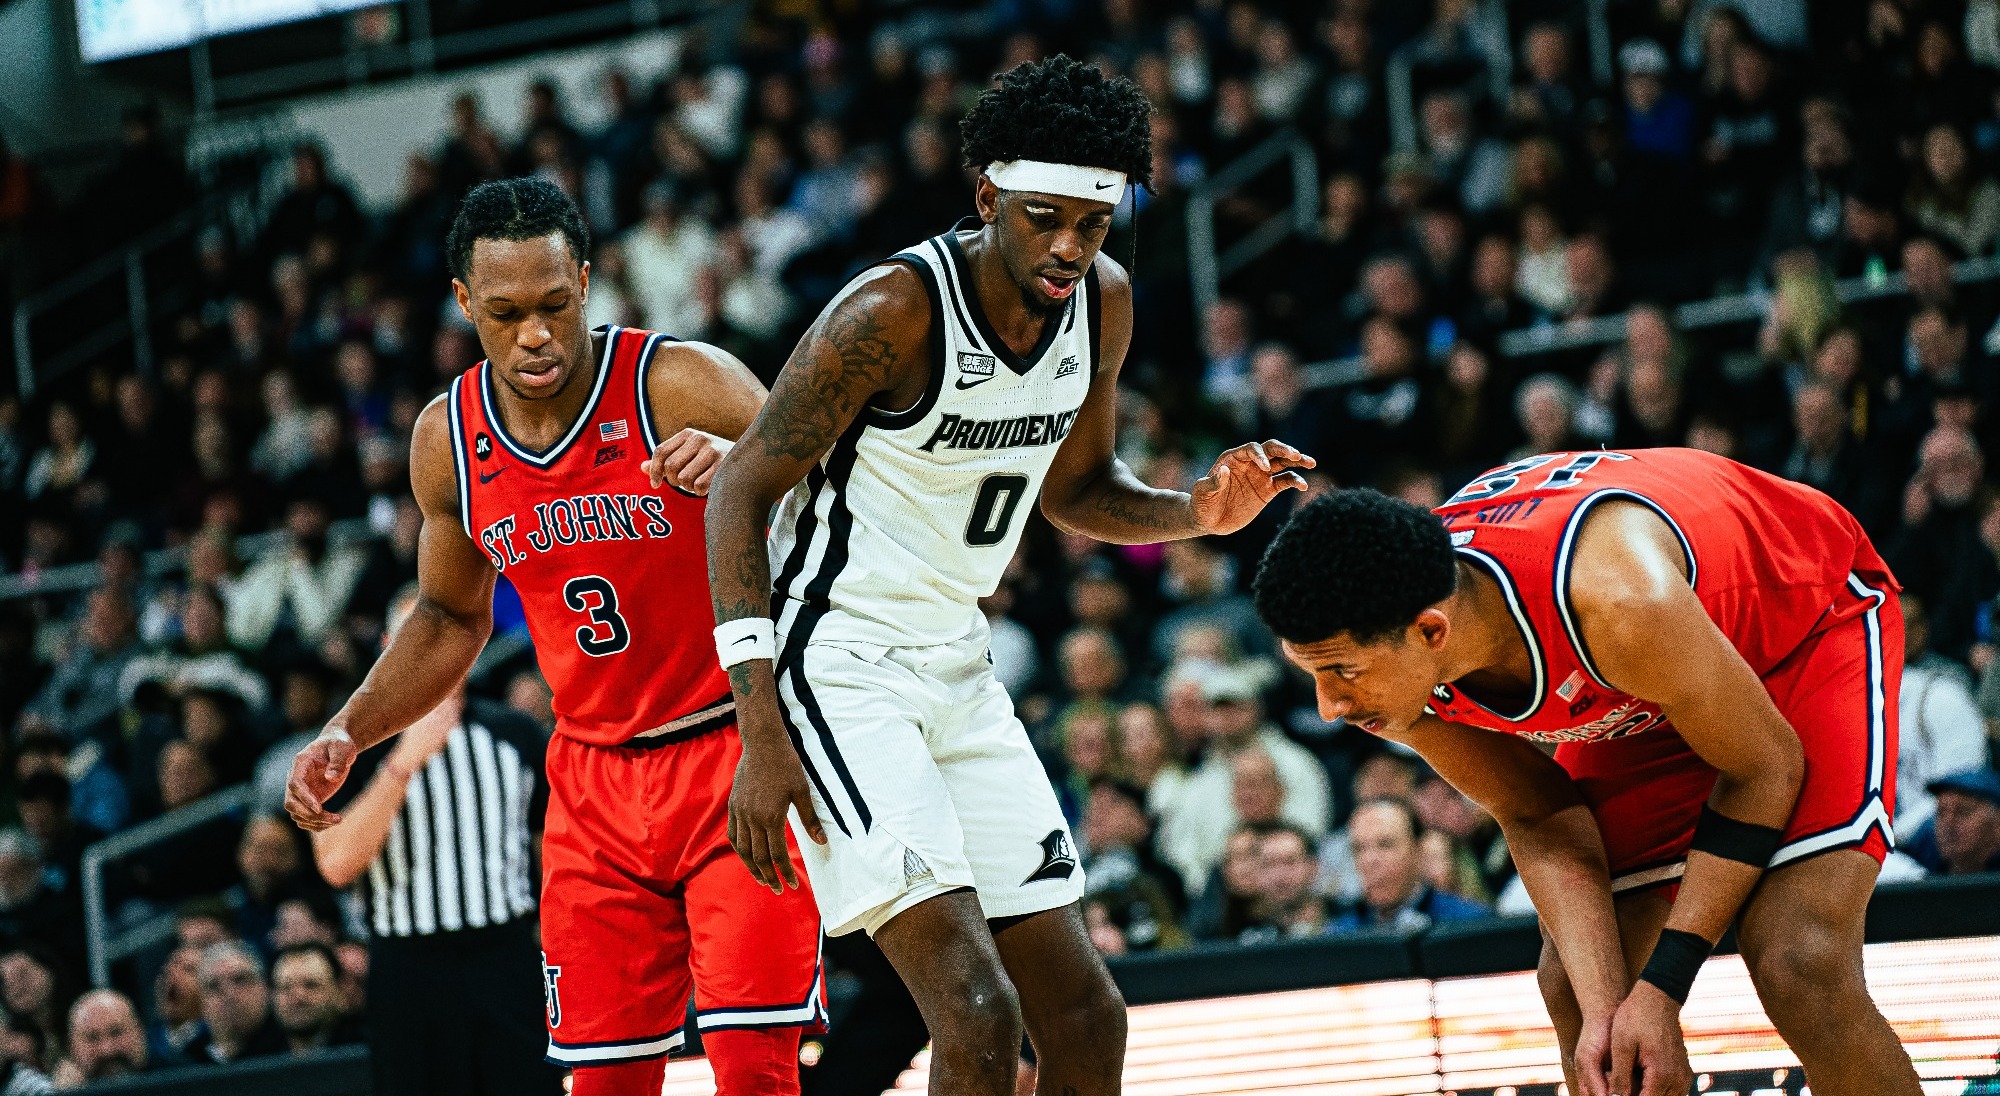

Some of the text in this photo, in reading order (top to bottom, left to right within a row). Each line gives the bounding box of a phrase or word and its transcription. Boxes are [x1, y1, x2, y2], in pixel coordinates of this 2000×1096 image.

[1056, 362, 1080, 375] EAST
[1060, 355, 1076, 366] BIG
[476, 437, 491, 454] JK
[916, 407, 1081, 455] PROVIDENC
[480, 494, 673, 573] ST. JOHN'S
[962, 472, 1030, 549] 0
[562, 574, 631, 658] 3
